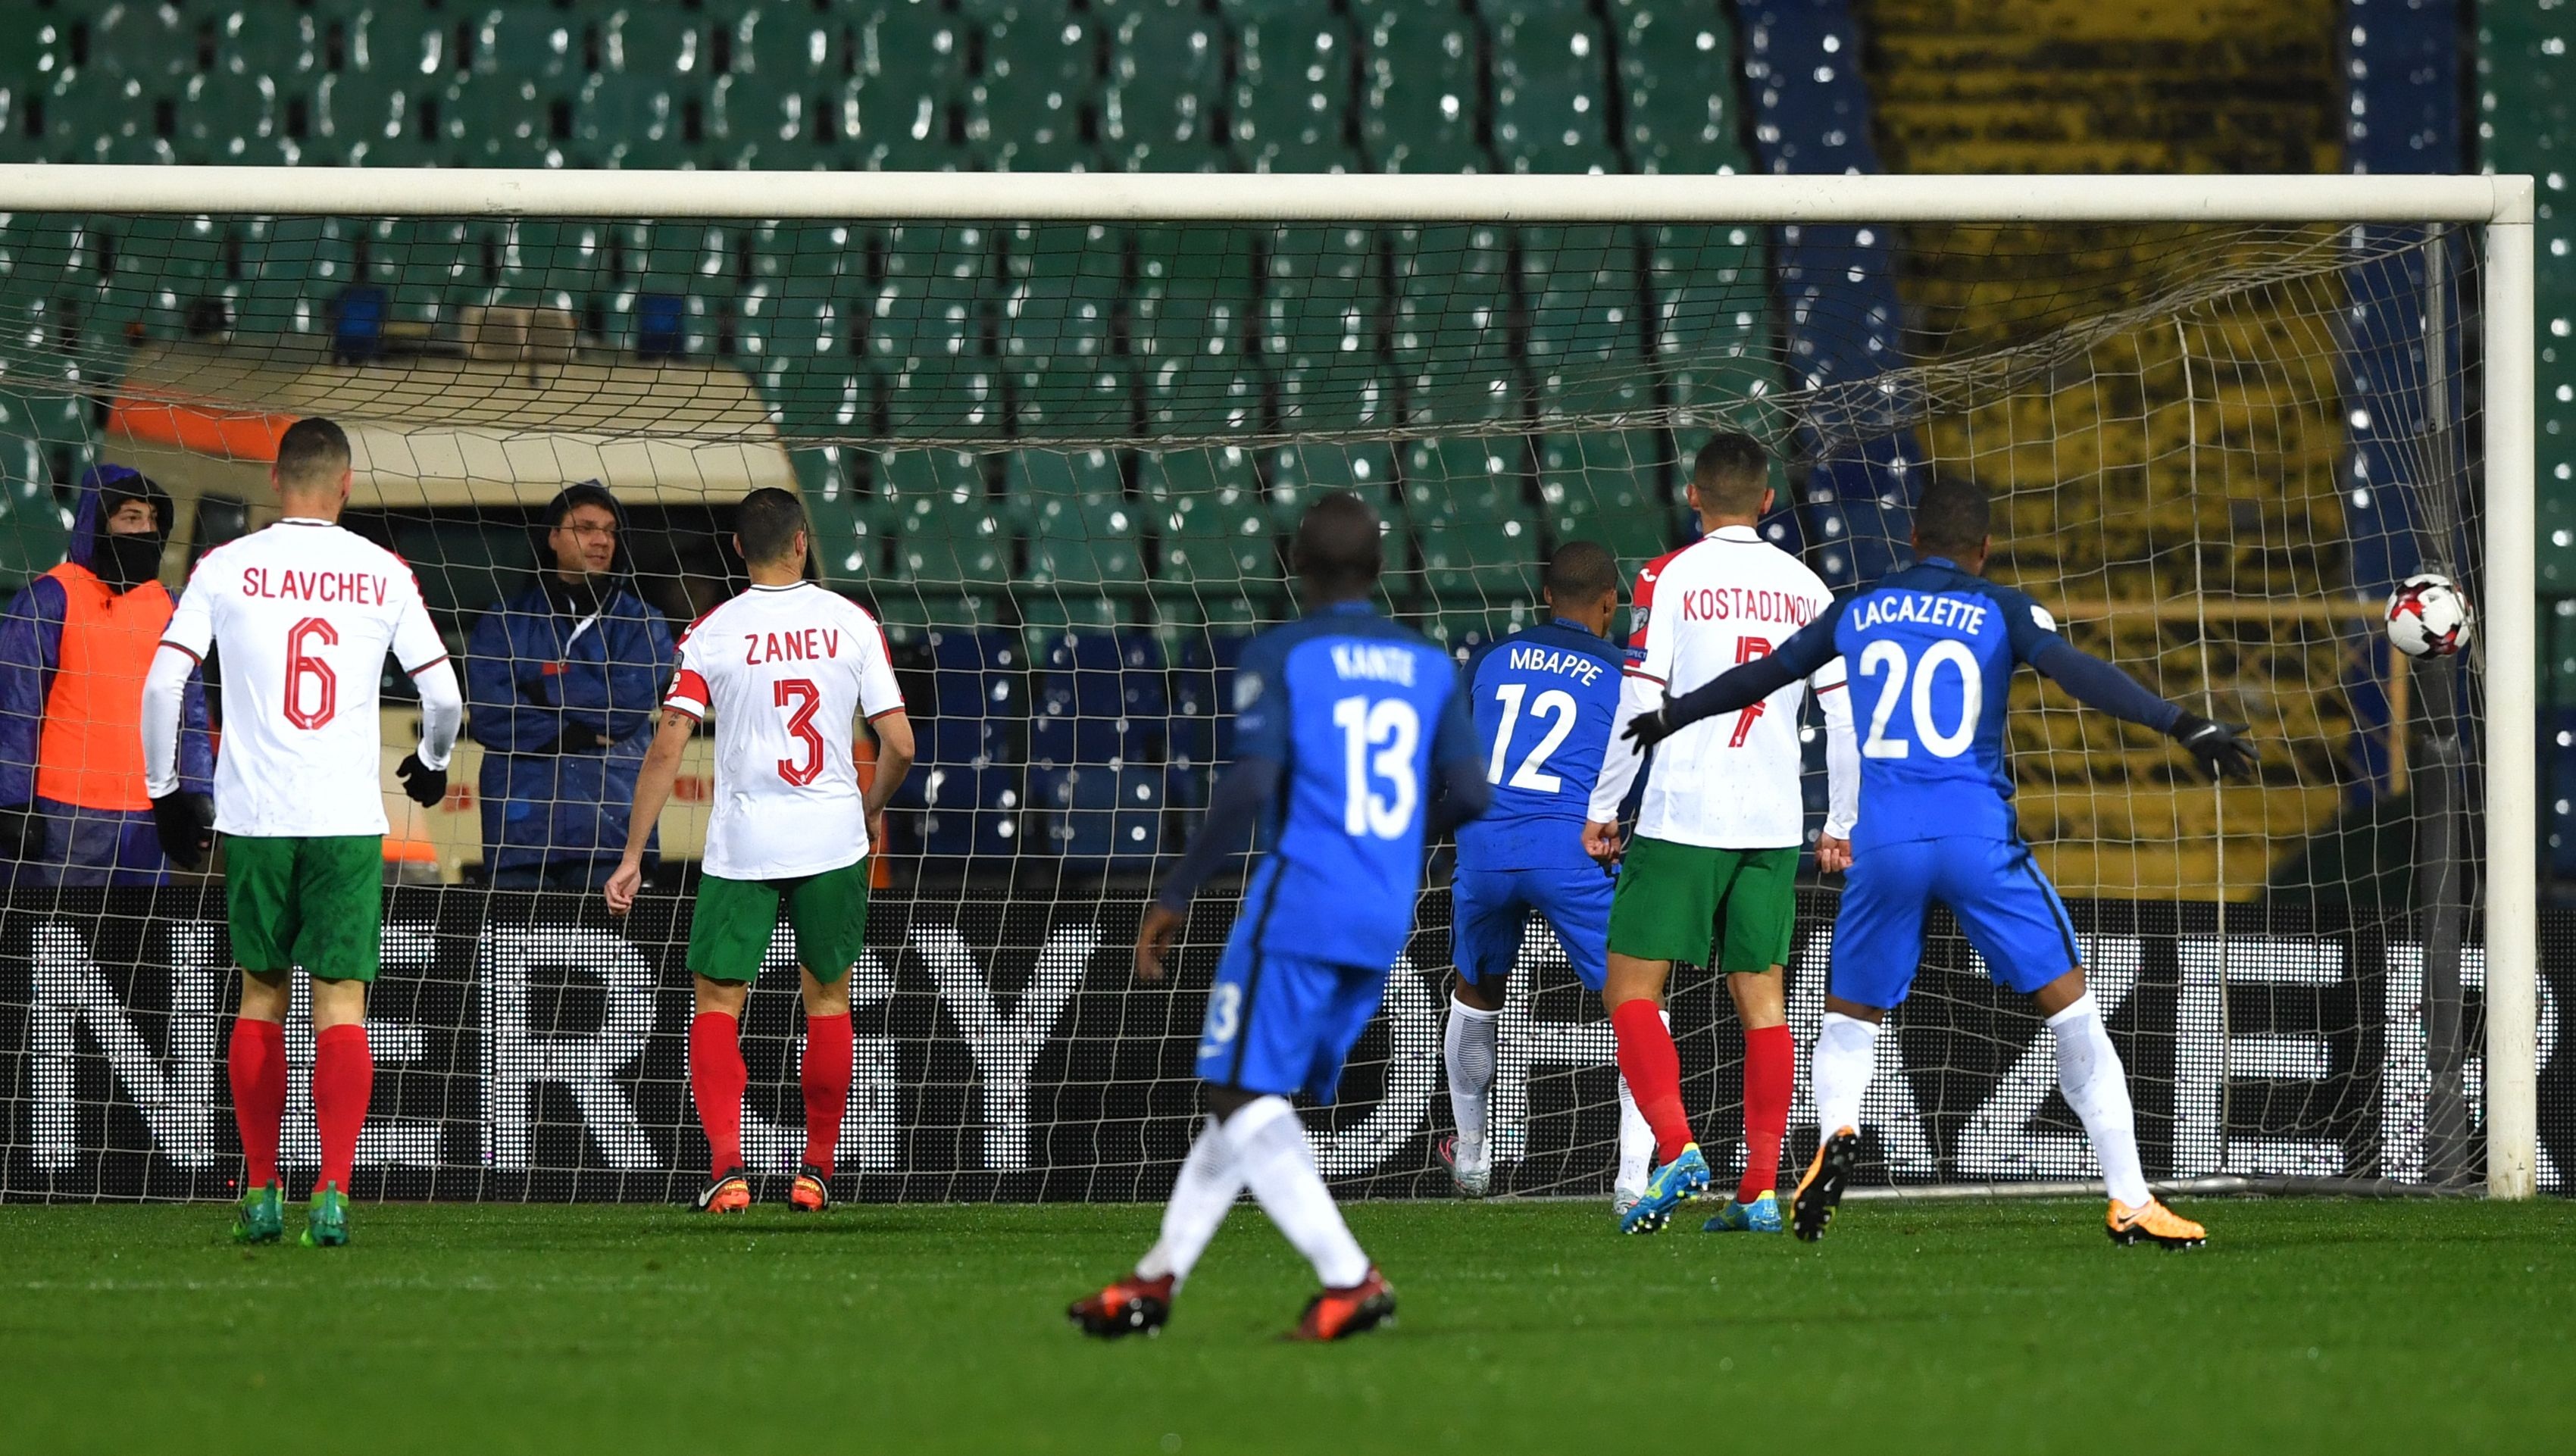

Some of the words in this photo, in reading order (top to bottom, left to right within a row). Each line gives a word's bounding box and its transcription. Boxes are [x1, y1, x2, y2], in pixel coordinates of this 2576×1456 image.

[243, 567, 386, 606] SLAVCHEV
[1683, 588, 1817, 628] KOSTADINOV
[1852, 595, 1987, 635] LACAZETTE
[283, 617, 339, 730] 6
[745, 629, 838, 665] ZANEV
[1509, 648, 1603, 686] MBAPPE
[1859, 639, 1982, 758] 20
[774, 679, 824, 786] 3
[1333, 694, 1420, 841] 13
[1486, 684, 1577, 793] 12
[32, 920, 1101, 1173] NERGY
